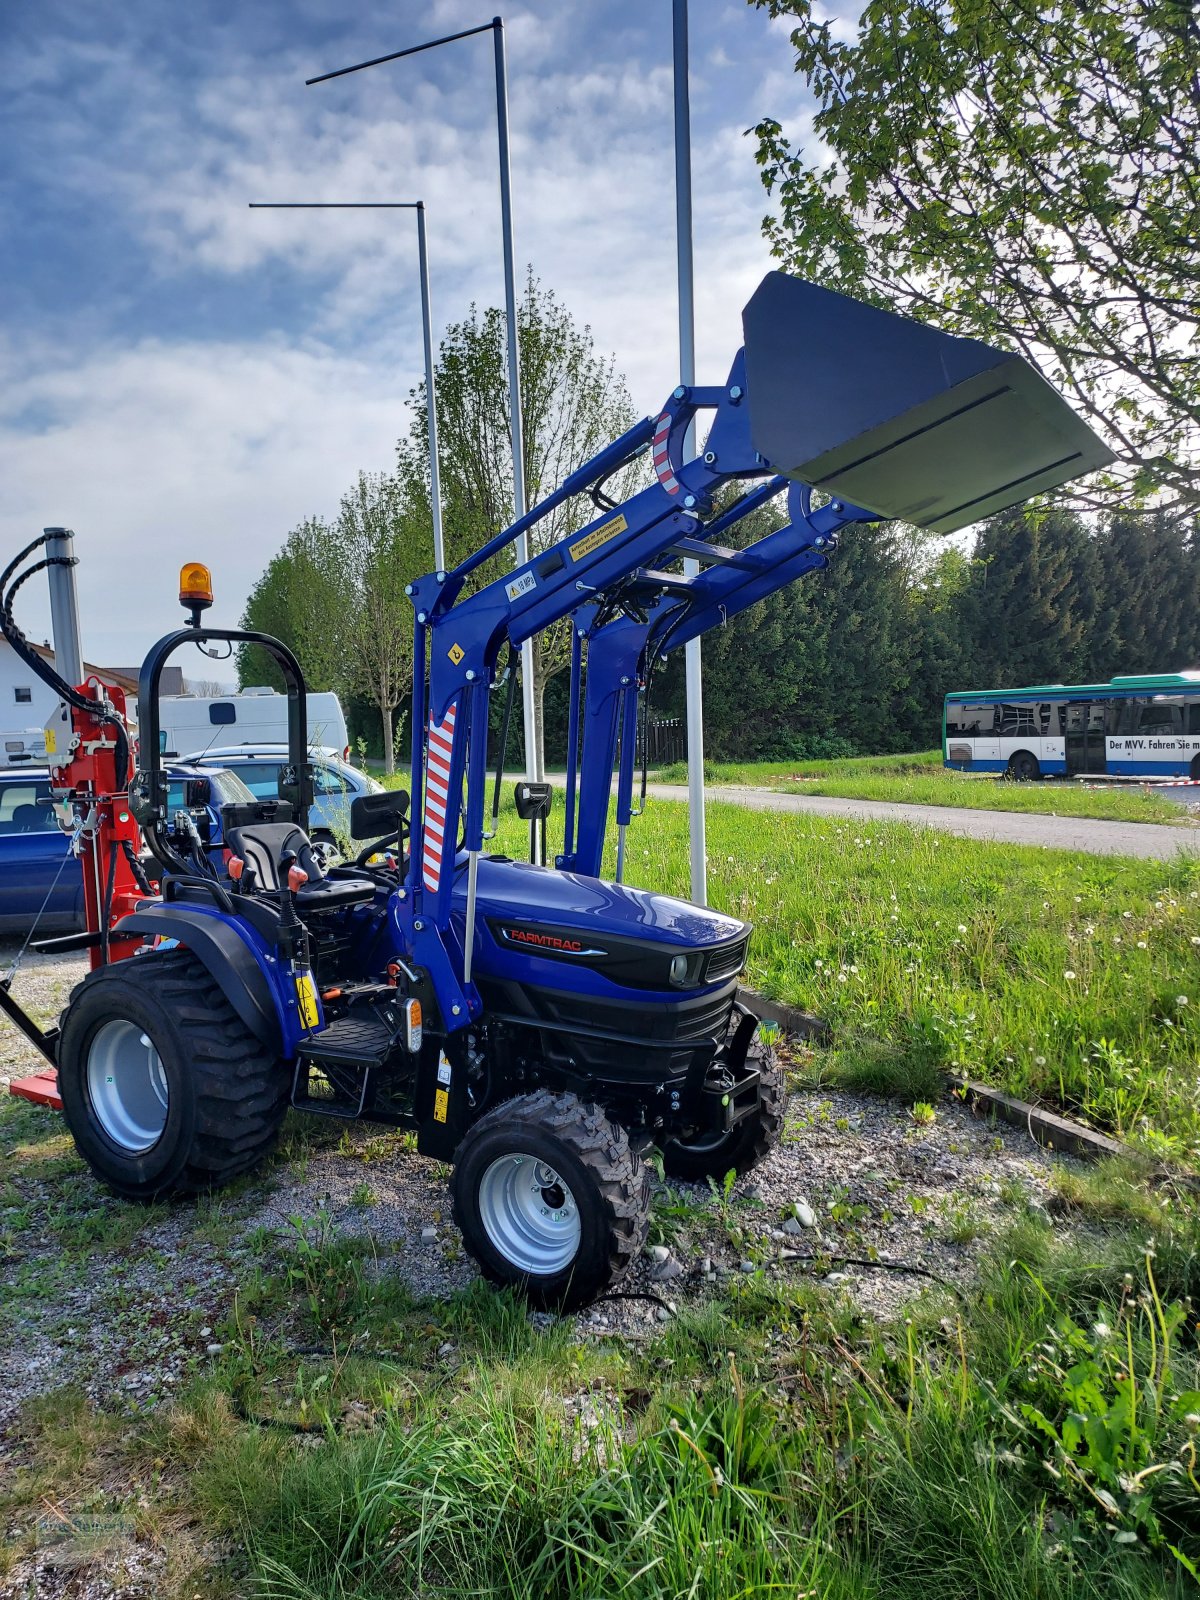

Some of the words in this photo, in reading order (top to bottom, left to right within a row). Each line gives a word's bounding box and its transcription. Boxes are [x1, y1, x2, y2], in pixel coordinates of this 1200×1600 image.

[596, 516, 623, 537] Arbeitsbereich
[604, 526, 621, 539] verboten
[1109, 740, 1123, 750] Der
[1125, 740, 1146, 750] MVV.
[1149, 739, 1176, 750] Fahren
[1178, 739, 1190, 750] Sie
[511, 929, 582, 952] FARMTRAC
